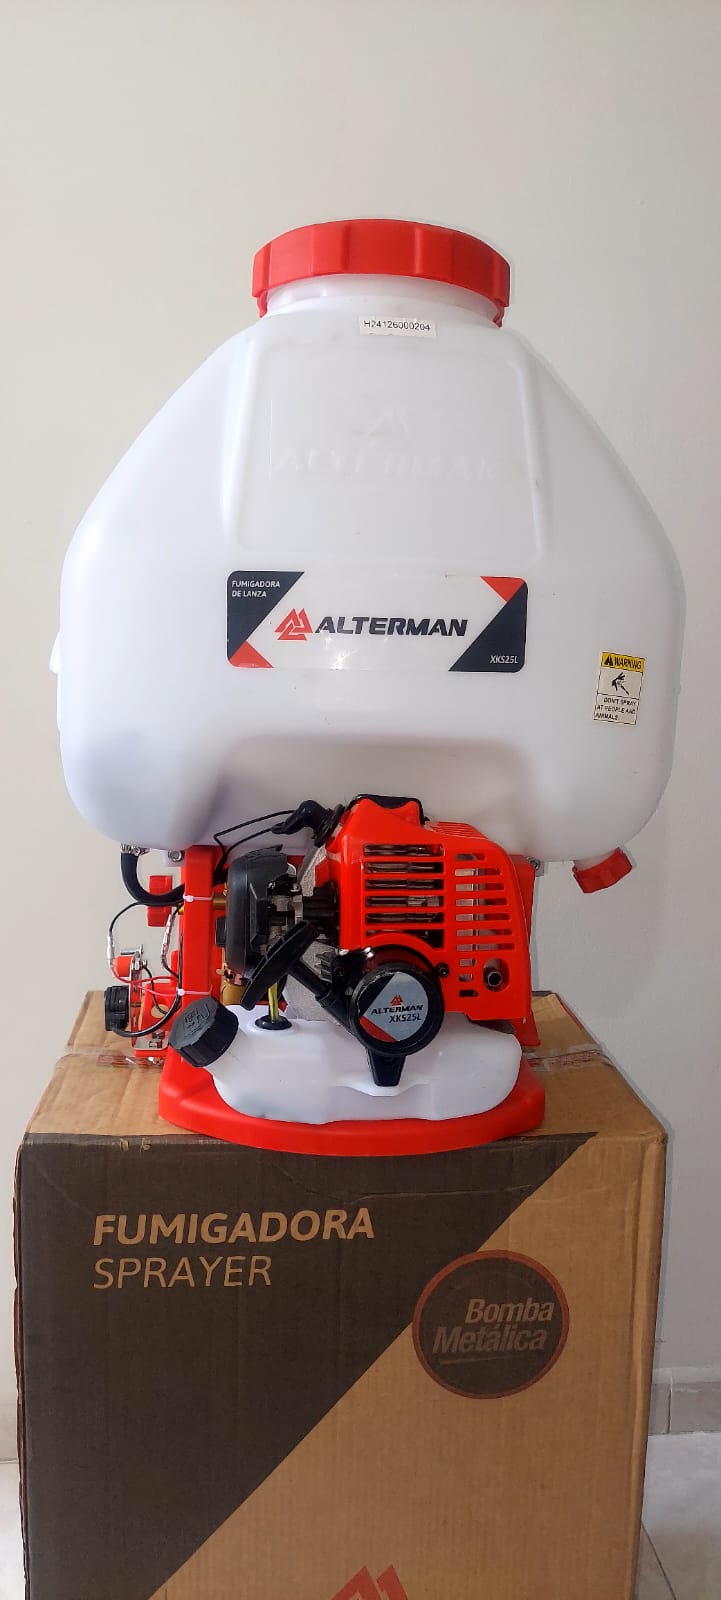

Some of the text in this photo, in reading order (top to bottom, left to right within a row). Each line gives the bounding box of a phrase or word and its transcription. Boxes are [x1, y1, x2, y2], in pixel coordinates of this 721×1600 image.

[231, 580, 281, 588] FUMIGADORA
[243, 590, 267, 598] LANZA
[315, 616, 468, 636] ALTERMAN
[489, 655, 518, 663] XKS25L
[614, 656, 642, 670] WARNING
[604, 705, 625, 713] PEOPLE
[371, 1004, 424, 1015] ALTERMAN
[389, 1013, 422, 1023] XKS25L
[93, 1207, 375, 1245] FUMIGADORA
[93, 1255, 272, 1289] SPRAYER
[465, 1297, 555, 1324] Bomba
[432, 1323, 547, 1354] Metálica
